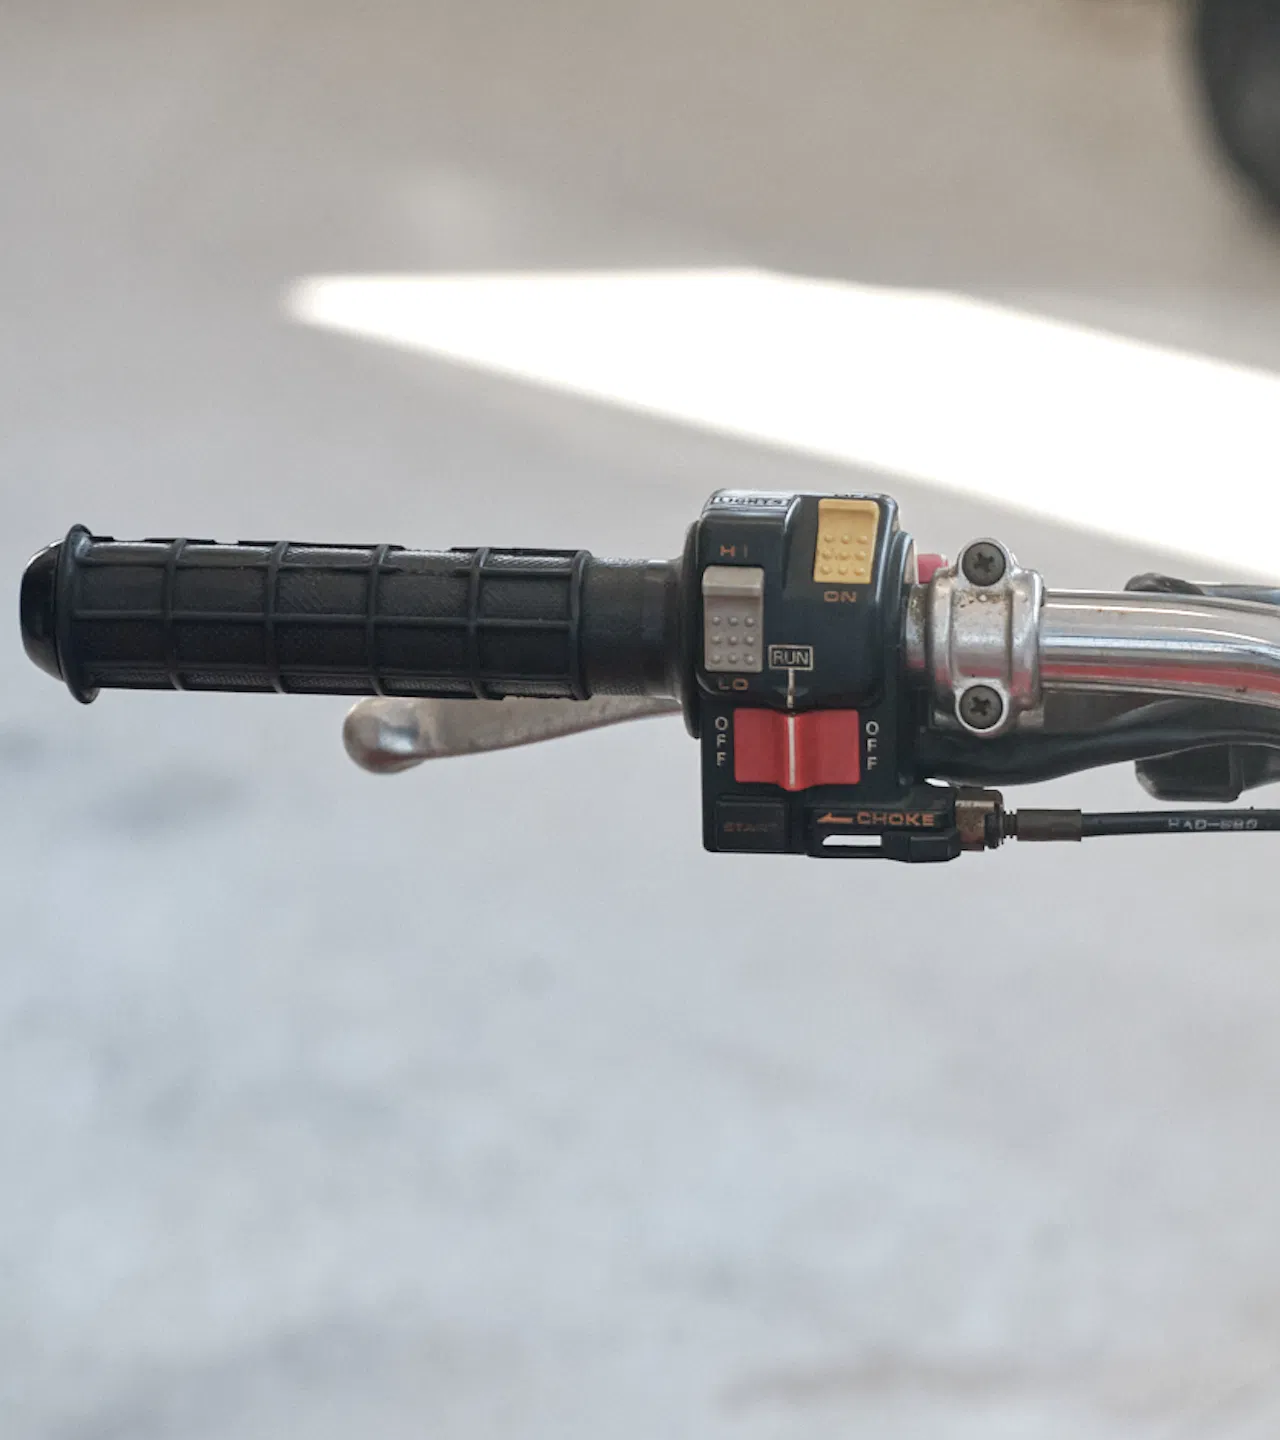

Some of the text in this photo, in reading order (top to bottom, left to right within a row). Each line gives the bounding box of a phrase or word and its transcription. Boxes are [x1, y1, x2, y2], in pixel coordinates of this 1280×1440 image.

[823, 591, 857, 603] ON
[773, 650, 810, 665] RUN
[717, 677, 749, 692] LO
[714, 716, 729, 767] OFF
[865, 720, 880, 771] OFF
[856, 811, 935, 828] CHOKE
